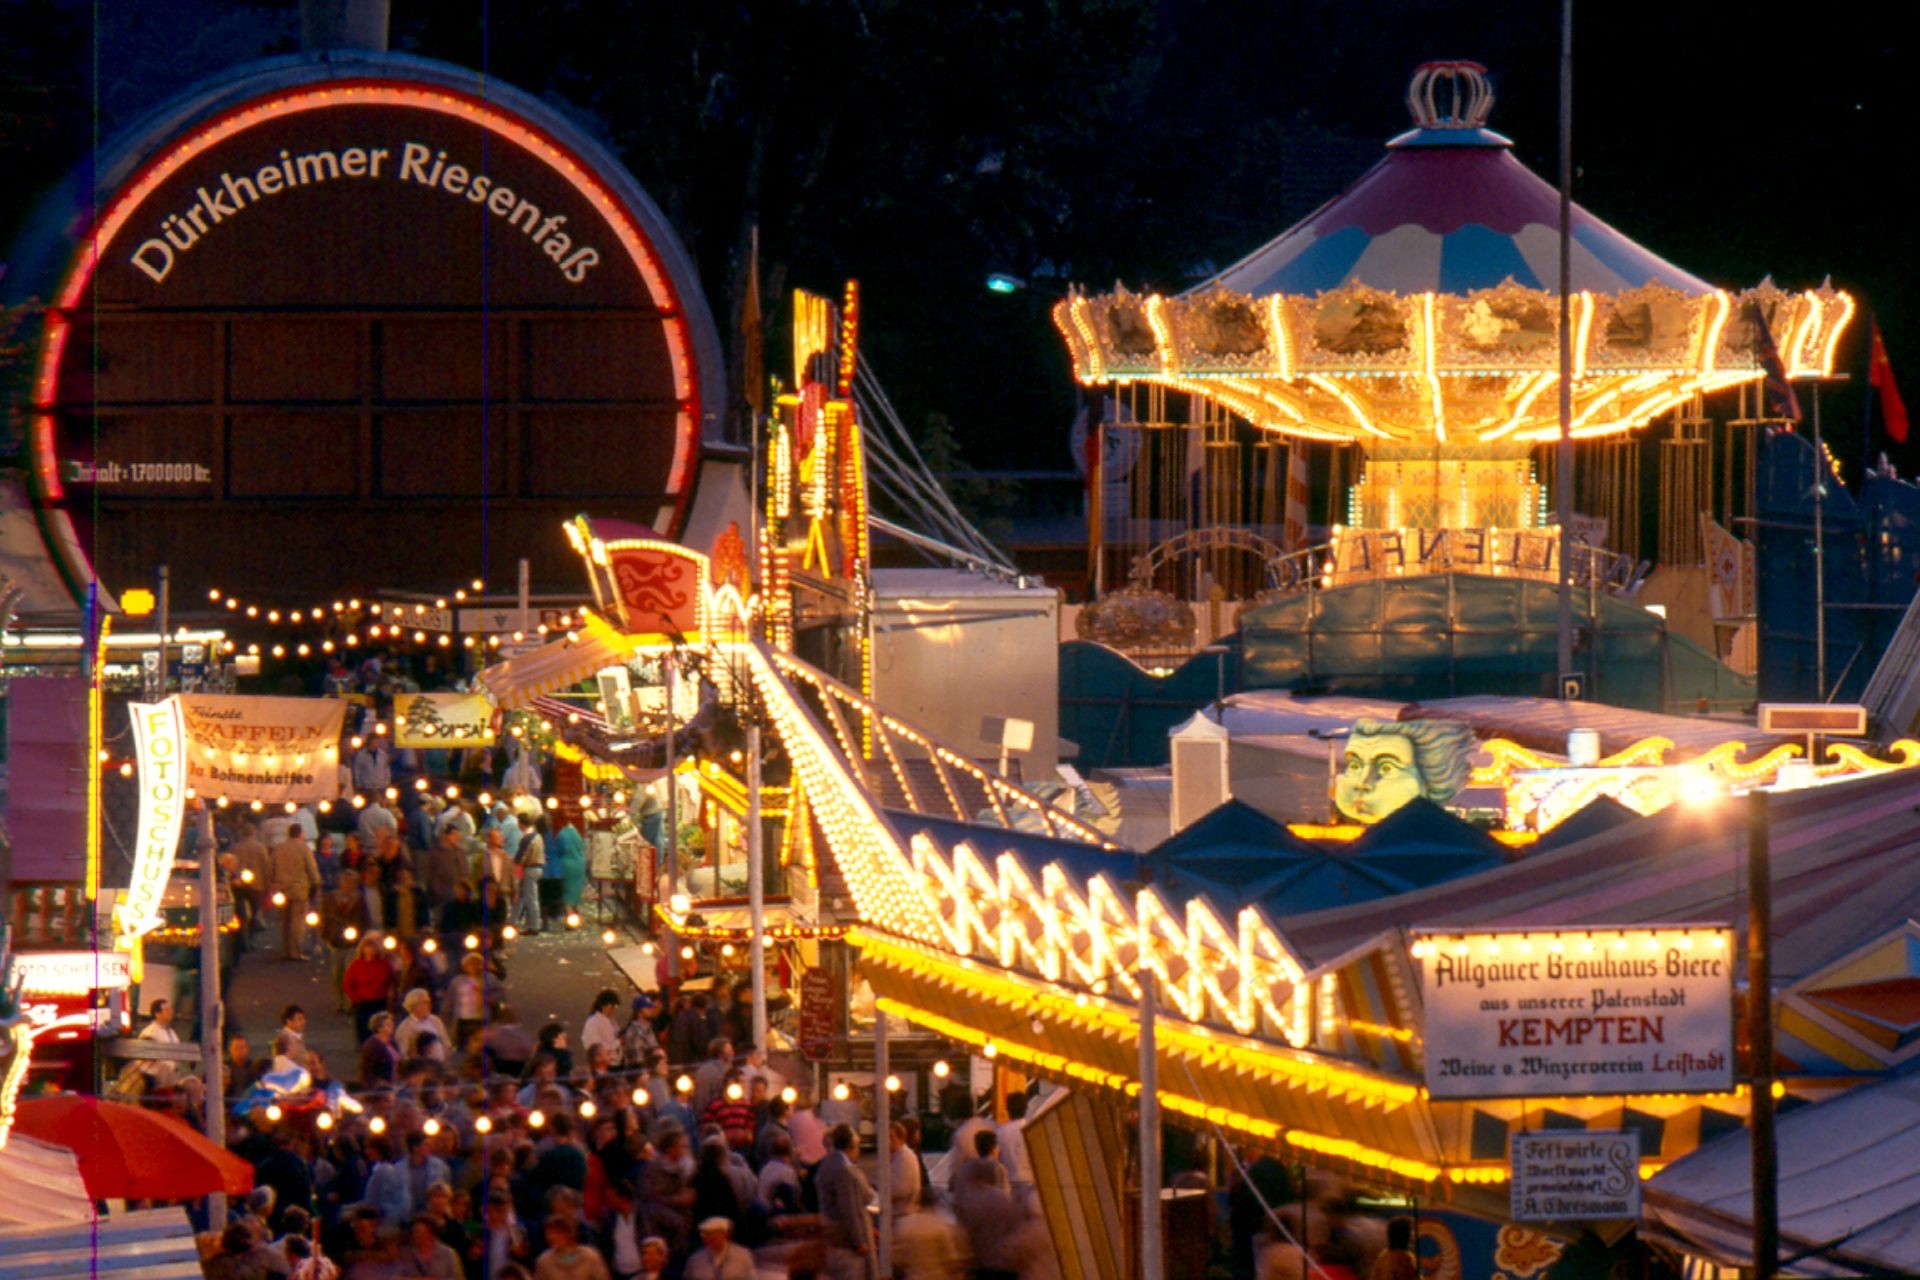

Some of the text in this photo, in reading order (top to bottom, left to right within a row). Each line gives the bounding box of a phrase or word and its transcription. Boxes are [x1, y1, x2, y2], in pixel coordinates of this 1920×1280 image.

[130, 142, 599, 283] Dürkheimer Riesenfaß
[210, 765, 315, 785] Bohnenkaffee
[129, 711, 174, 920] FOTOSCHUSS
[53, 962, 129, 977] SCHIESEN
[1479, 987, 1686, 1014] aus unserer Patenstadt
[1498, 1015, 1665, 1048] KEMPTEN
[1439, 1057, 1496, 1077] Weine
[1519, 1055, 1644, 1081] Winzerverein
